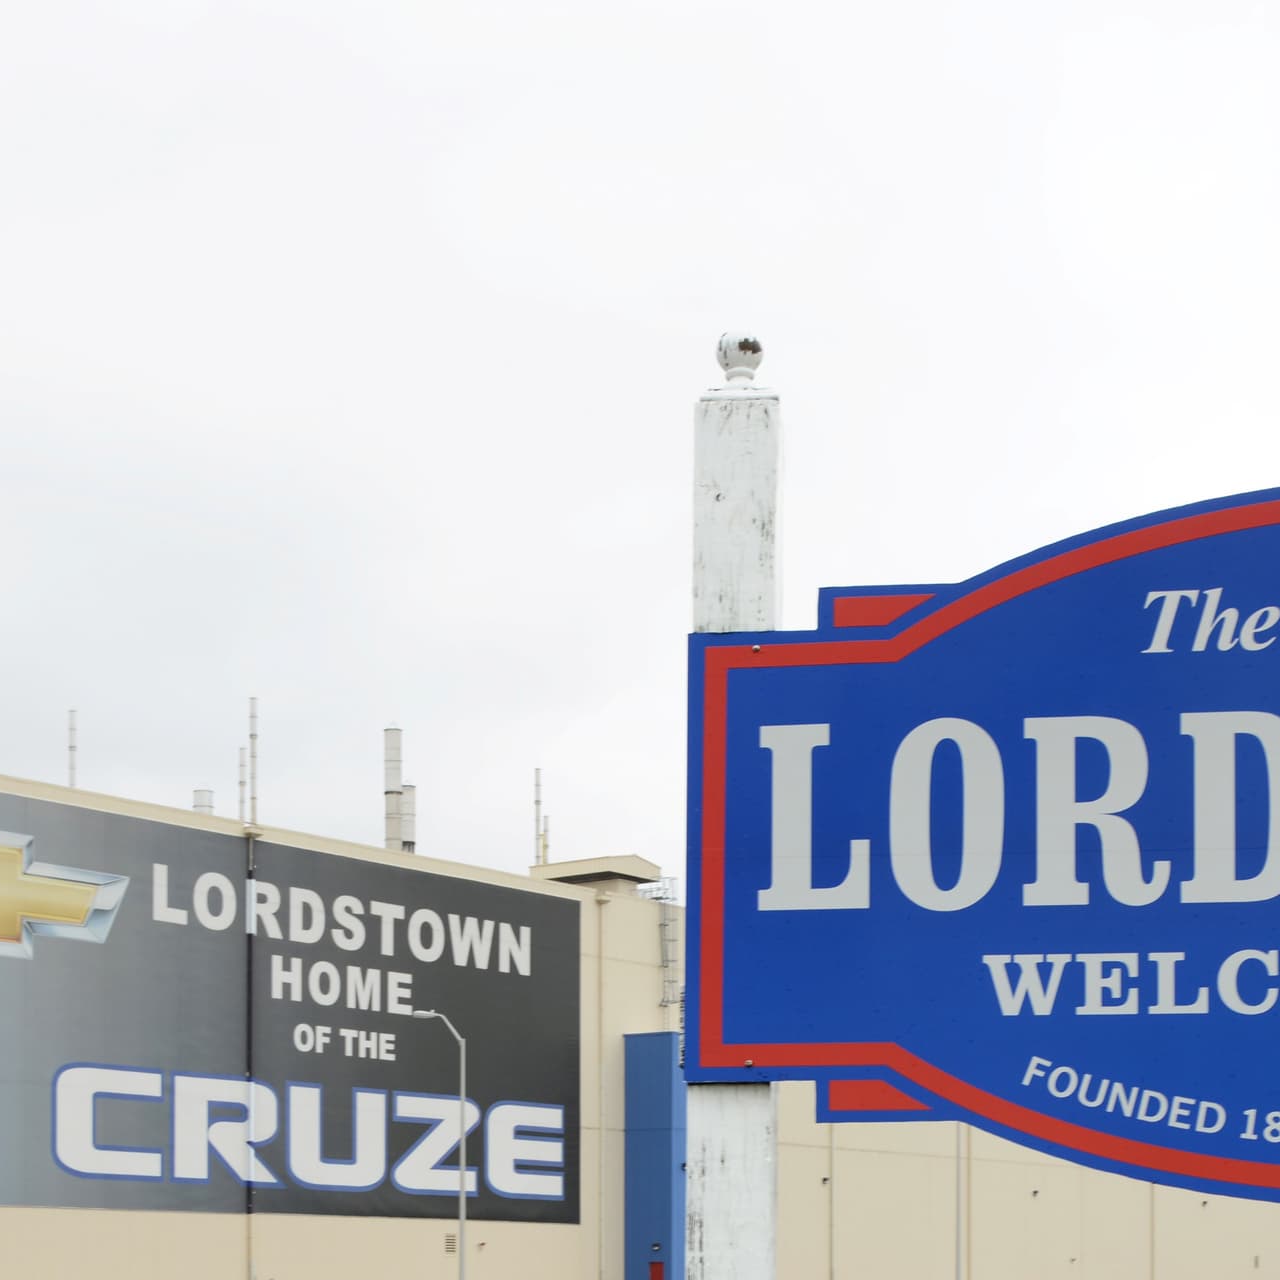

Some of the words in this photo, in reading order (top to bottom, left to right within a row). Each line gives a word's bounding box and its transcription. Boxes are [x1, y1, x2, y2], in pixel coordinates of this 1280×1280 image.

[1140, 587, 1280, 654] The
[151, 863, 532, 976] LORDSTOWN
[270, 954, 414, 1016] HOME
[293, 1023, 332, 1054] OF
[338, 1027, 396, 1062] THE
[52, 1061, 565, 1200] CRUZE
[1021, 1055, 1227, 1135] FOUNDED
